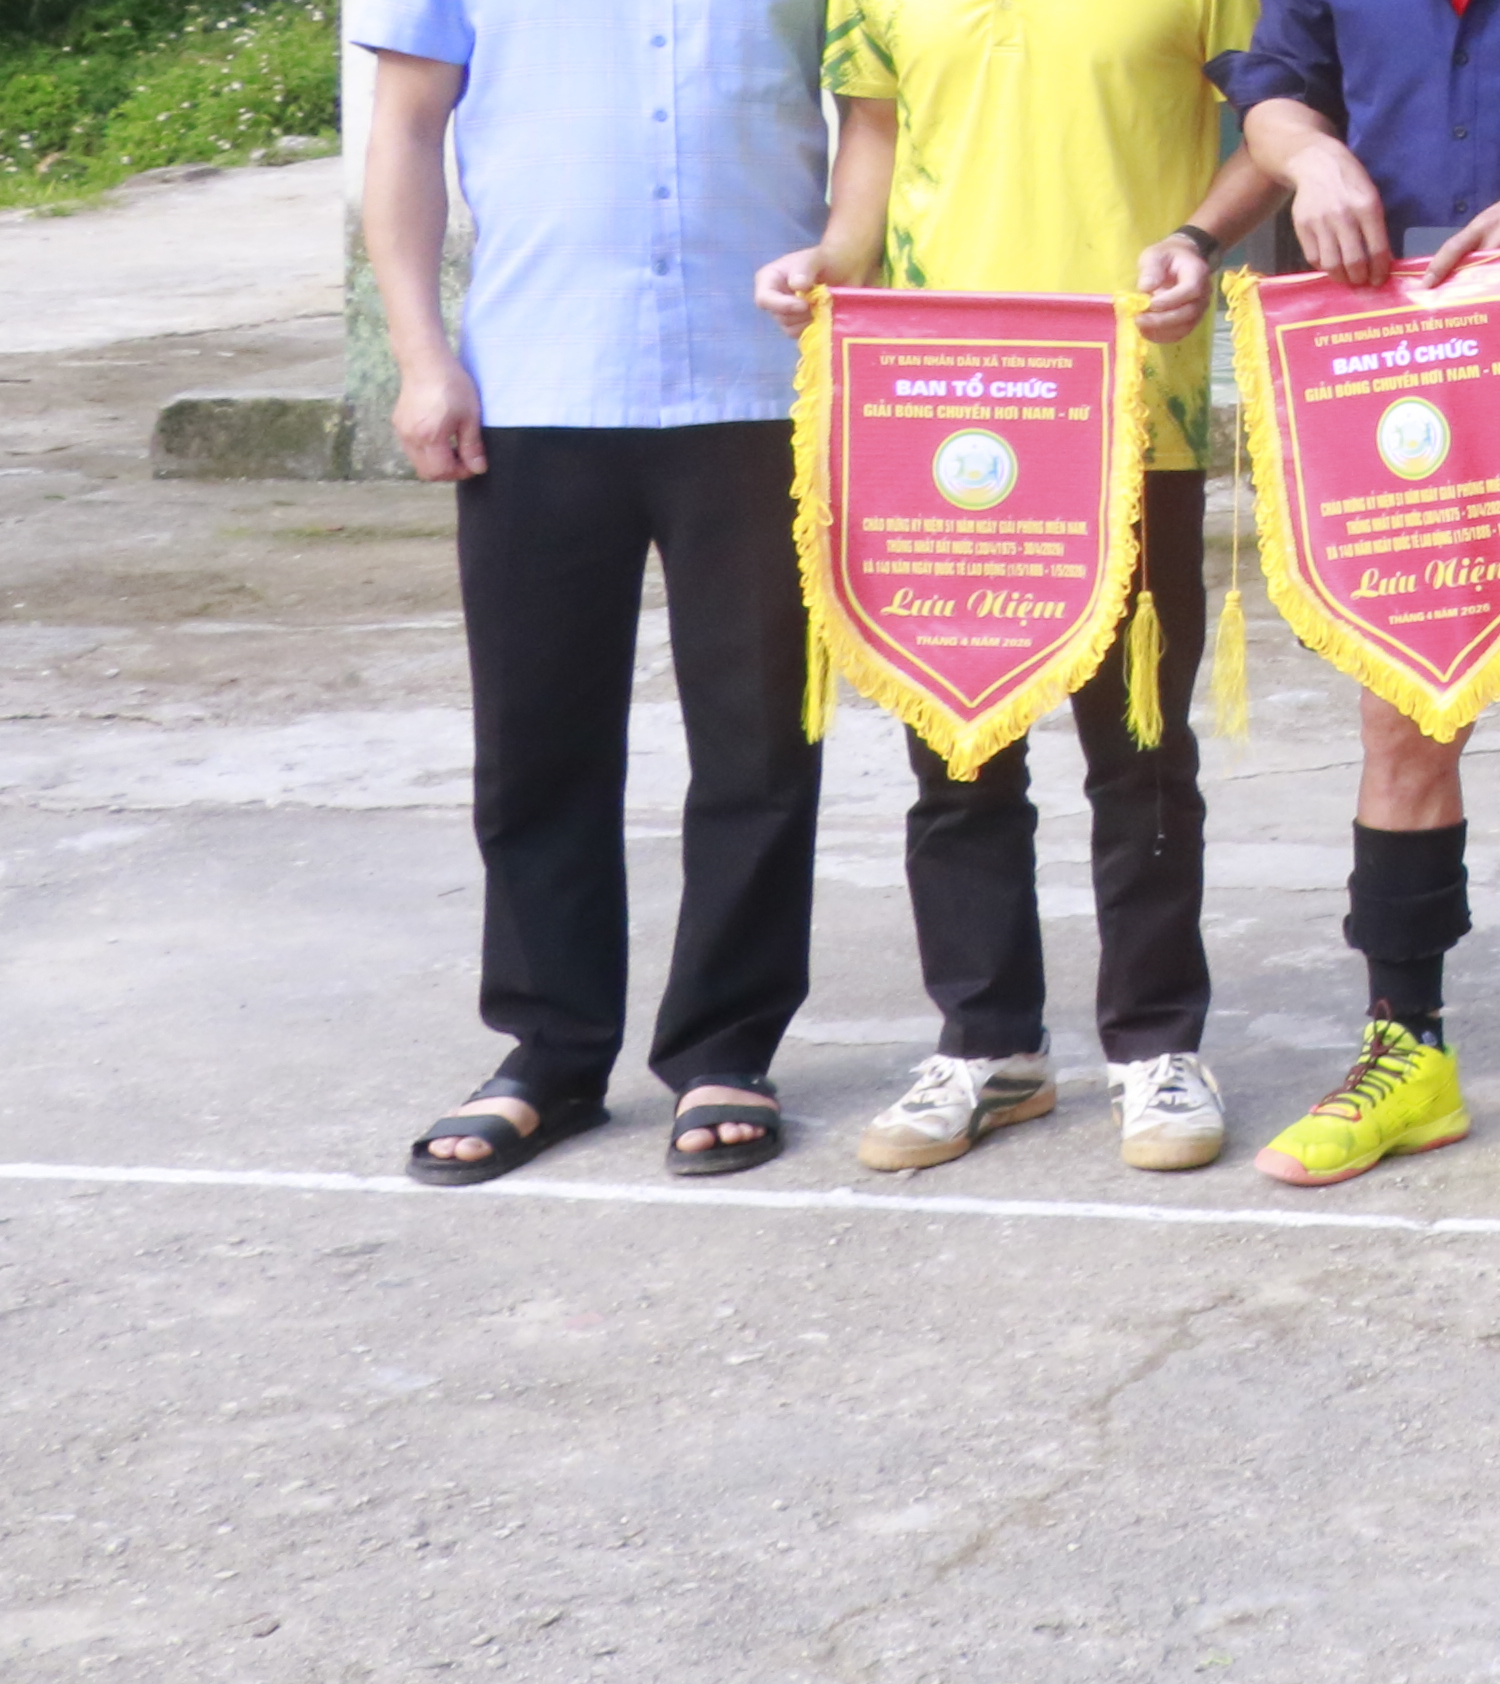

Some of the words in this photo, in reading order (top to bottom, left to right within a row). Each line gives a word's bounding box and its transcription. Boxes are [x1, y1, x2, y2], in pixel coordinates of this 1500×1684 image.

[1333, 353, 1379, 375] BAN
[1381, 340, 1412, 367] TỔ
[1414, 338, 1478, 363] CHỨC
[896, 379, 947, 396] BAN
[951, 372, 984, 398] TỔ
[989, 378, 1057, 399] CHỨC
[1350, 568, 1417, 600] Lưu
[880, 587, 955, 617] Lưu
[967, 590, 1066, 627] Niệm
